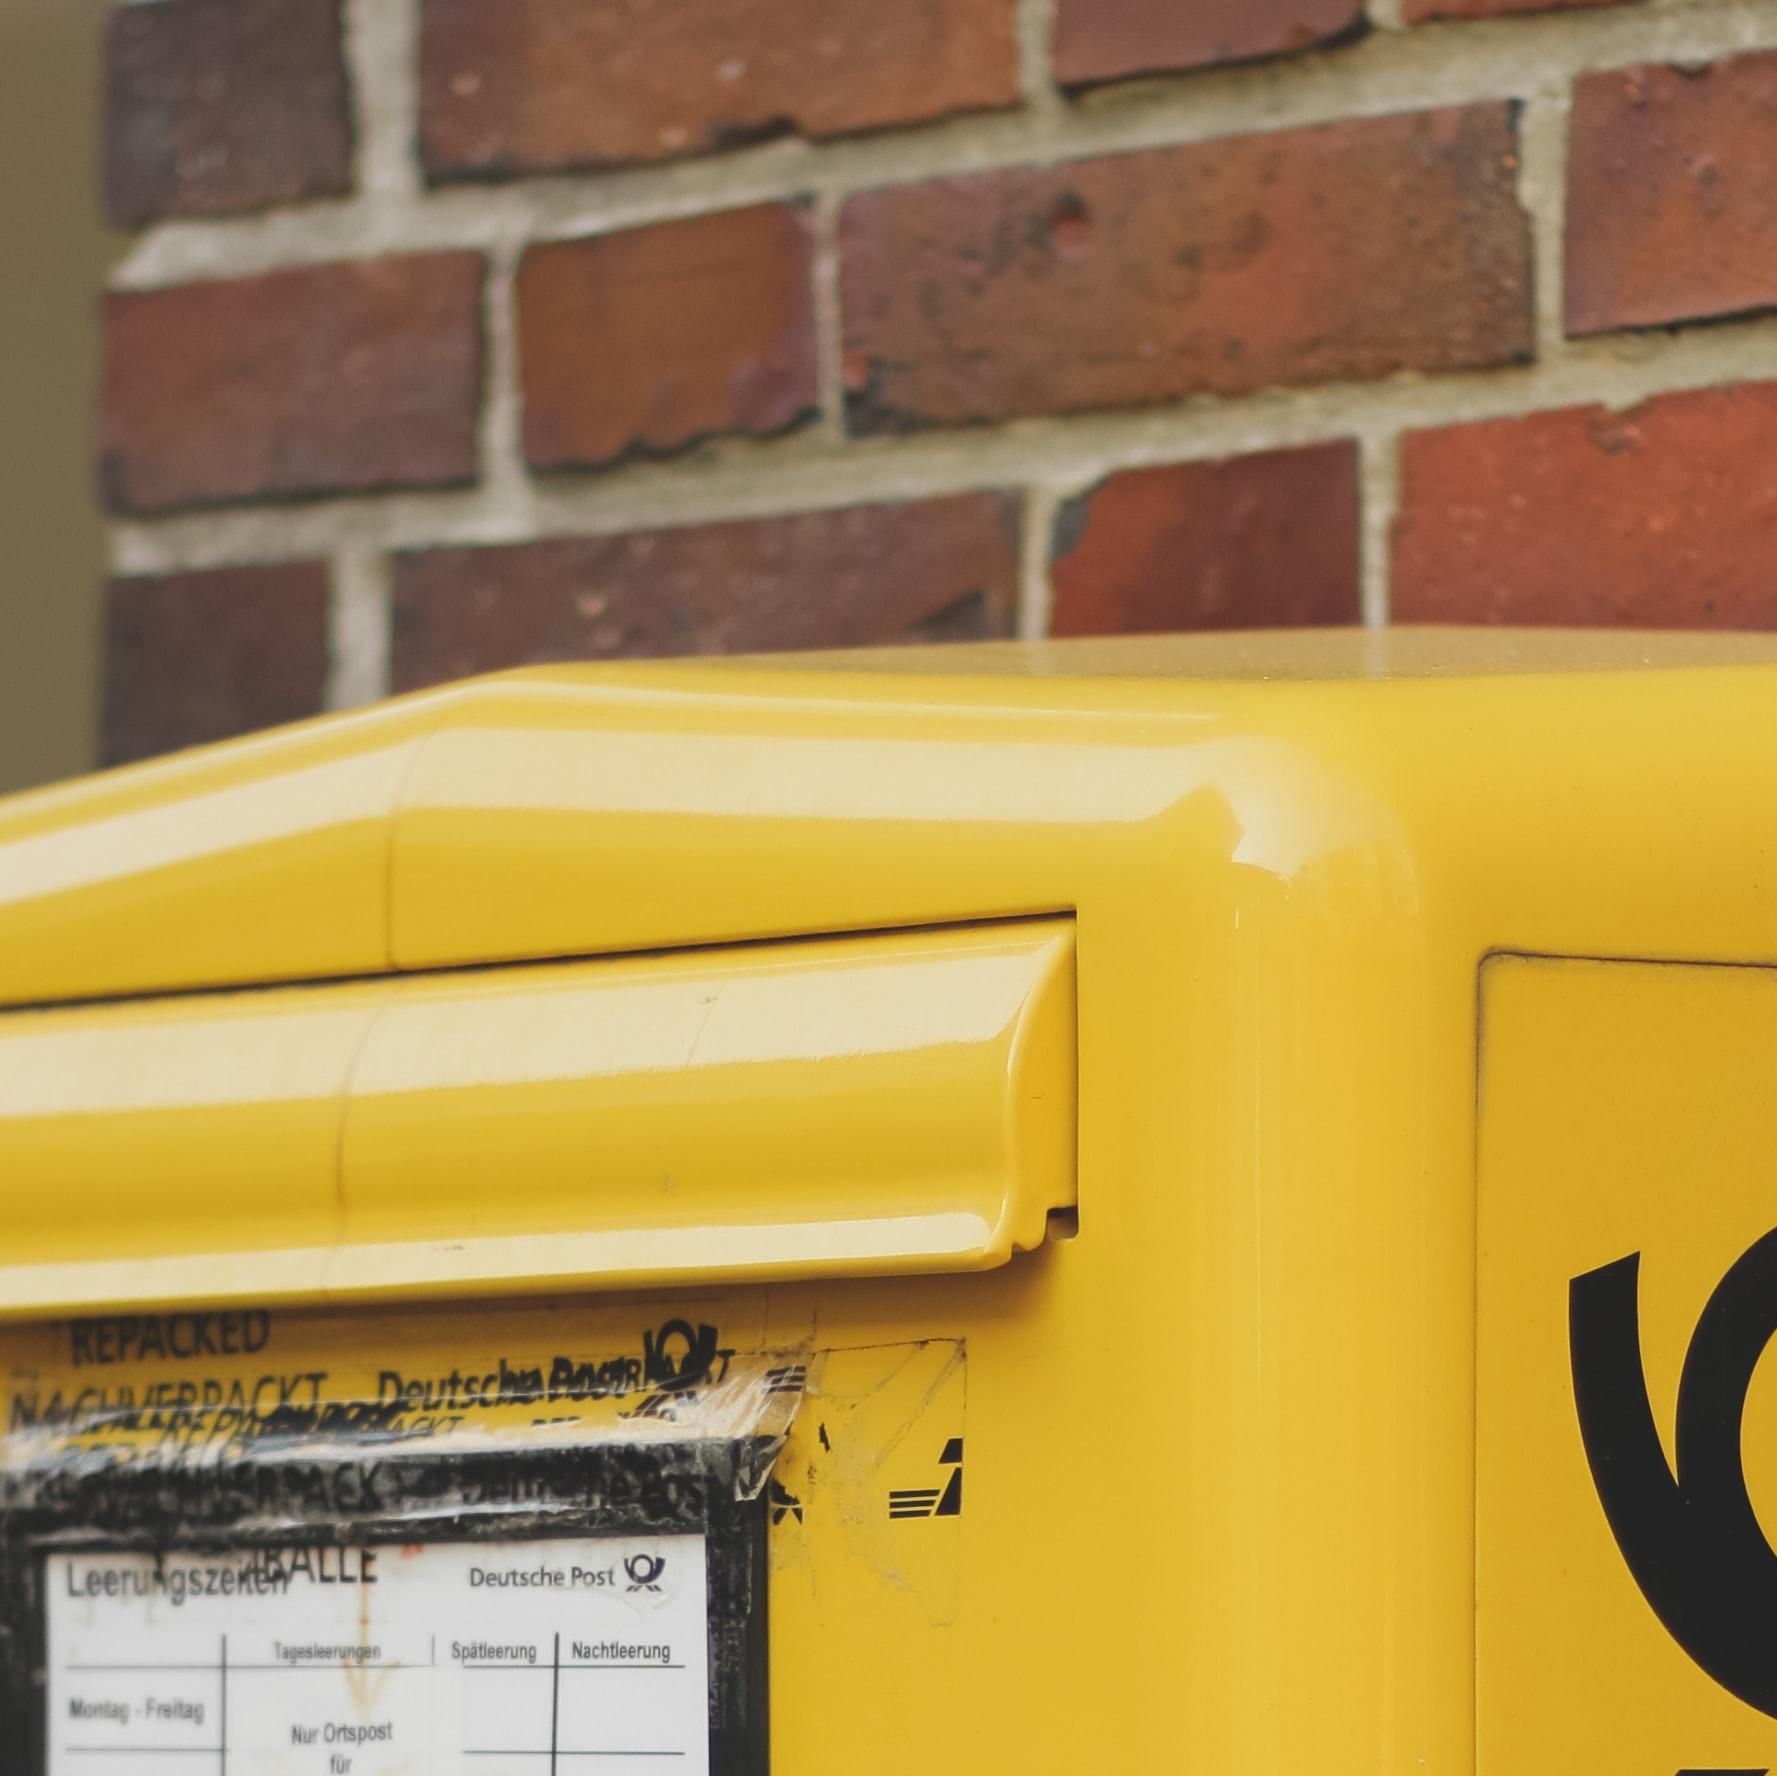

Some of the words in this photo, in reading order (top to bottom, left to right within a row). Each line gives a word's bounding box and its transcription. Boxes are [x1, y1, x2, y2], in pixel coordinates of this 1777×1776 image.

[70, 1309, 271, 1367] REPACKED
[67, 1560, 290, 1606] Leerungszeiten
[469, 1566, 565, 1587] Deutsche
[571, 1566, 615, 1586] Post
[273, 1641, 381, 1664] Tagesleerungen
[451, 1641, 537, 1663] Spätleerung
[572, 1641, 671, 1663] Nachtleerung
[68, 1696, 129, 1725] Montag
[145, 1697, 205, 1726] Freitag
[292, 1724, 319, 1745] Nur
[324, 1721, 394, 1747] Ortspost
[330, 1754, 352, 1775] für
